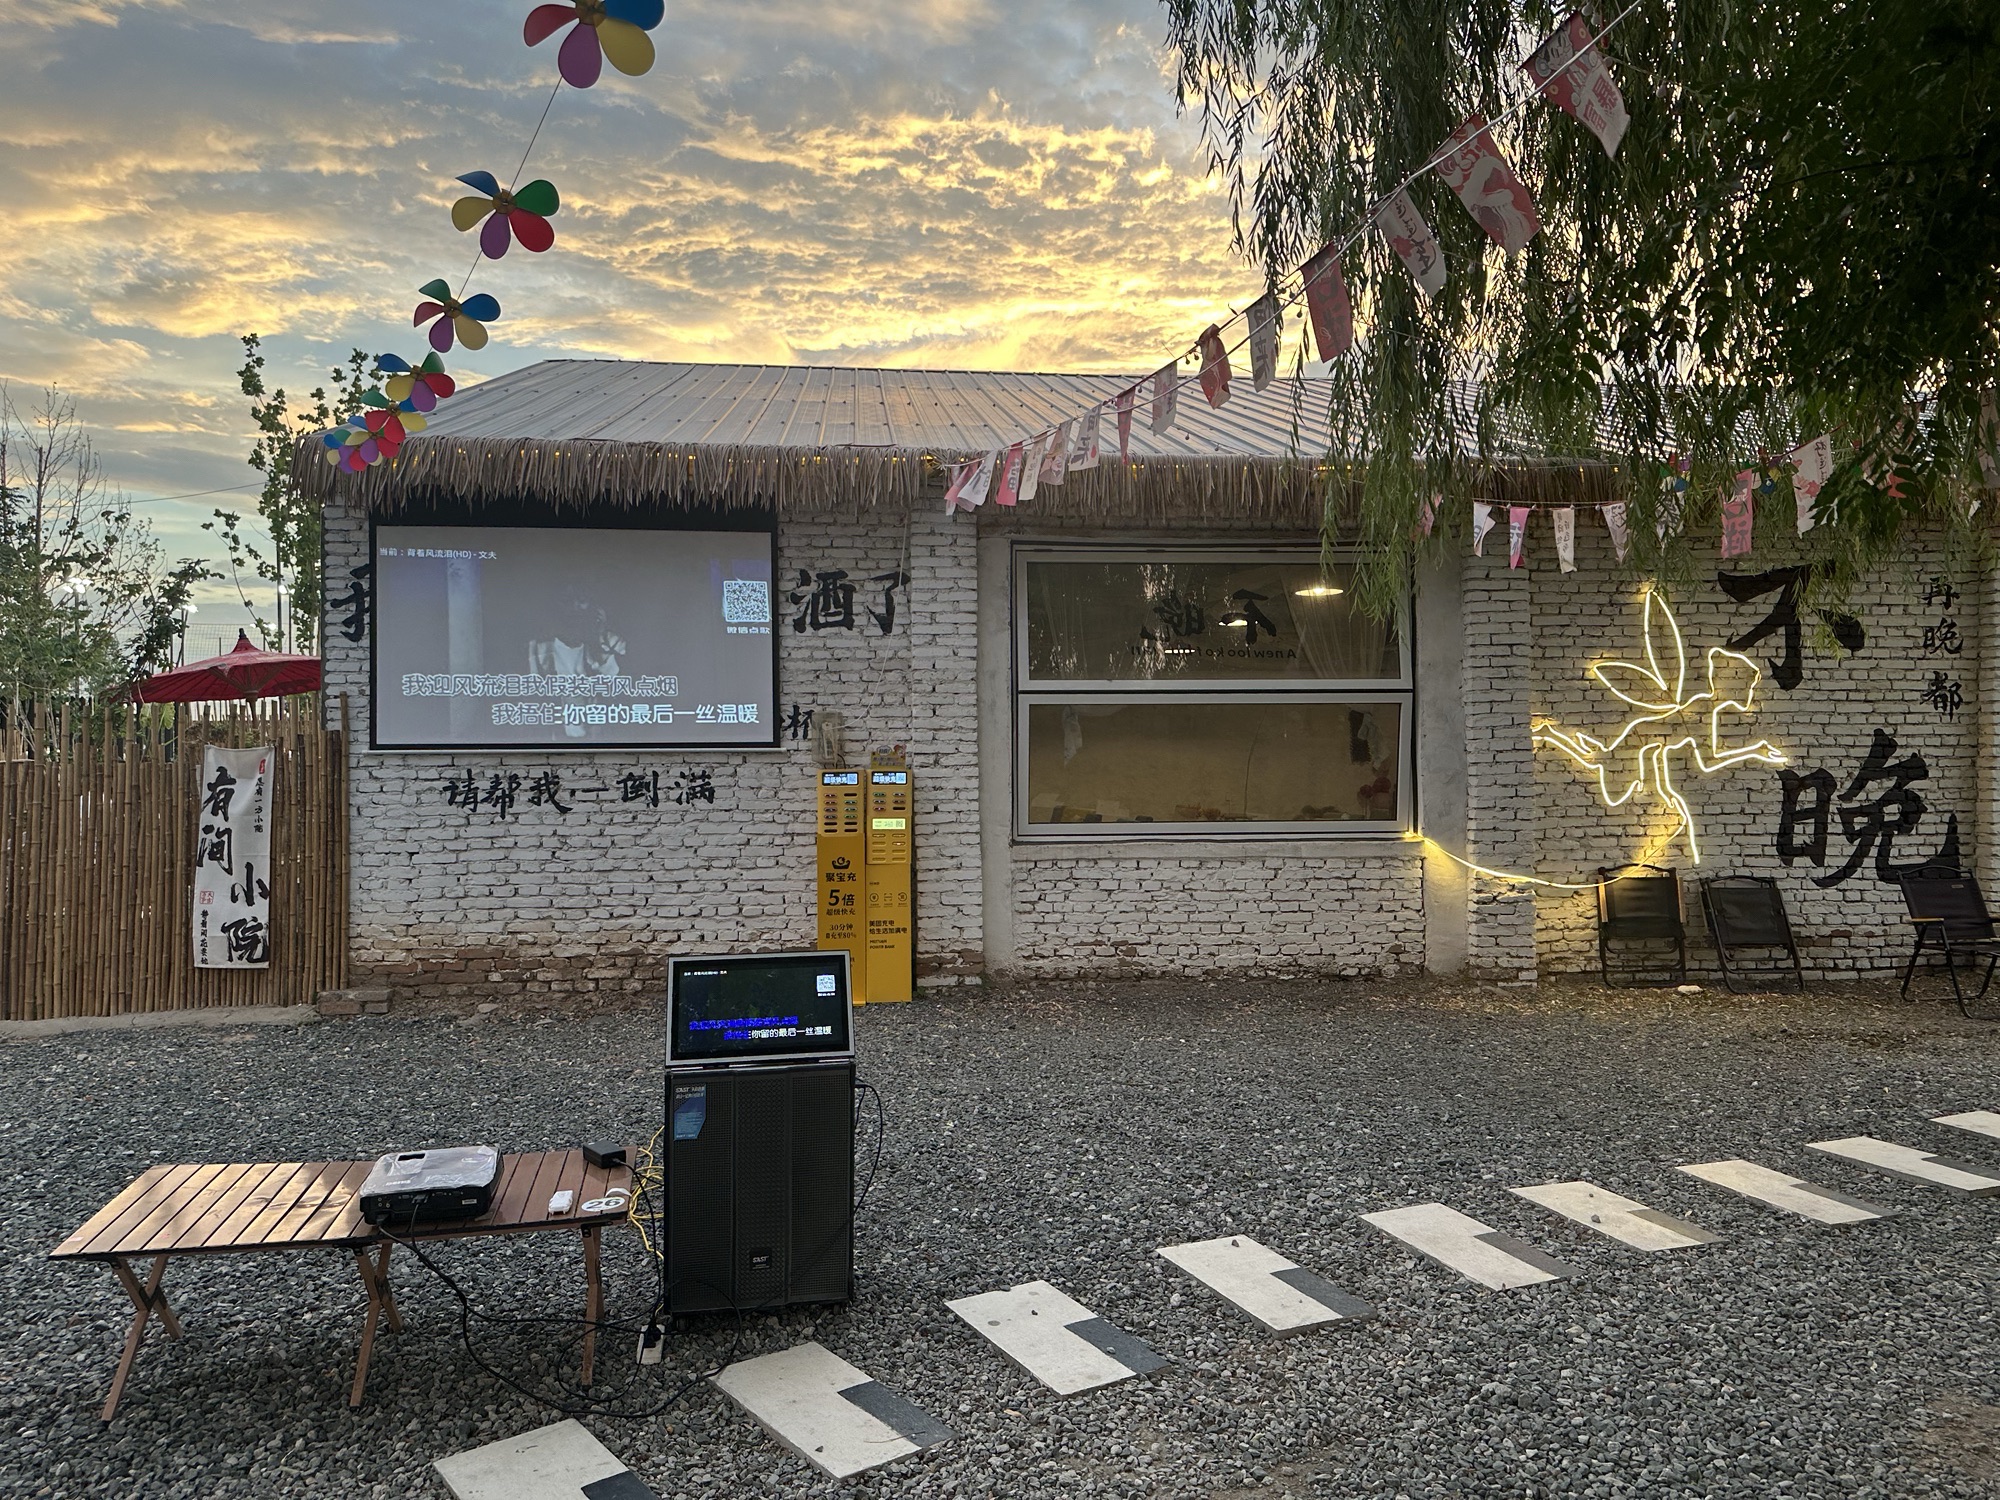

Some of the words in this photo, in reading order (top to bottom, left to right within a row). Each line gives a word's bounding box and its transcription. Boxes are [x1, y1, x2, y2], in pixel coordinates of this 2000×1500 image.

[788, 568, 911, 634] 酒了
[1920, 577, 1964, 722] 再晚都
[402, 674, 679, 697] 我迎风流泪我假装背风点烟
[492, 703, 760, 726] 我捂住你留的最后一丝温暖
[443, 768, 716, 820] 请帮我一倒满
[197, 766, 270, 964] 有间小院
[825, 872, 857, 882] 聚宝充
[586, 1198, 621, 1209] 26
